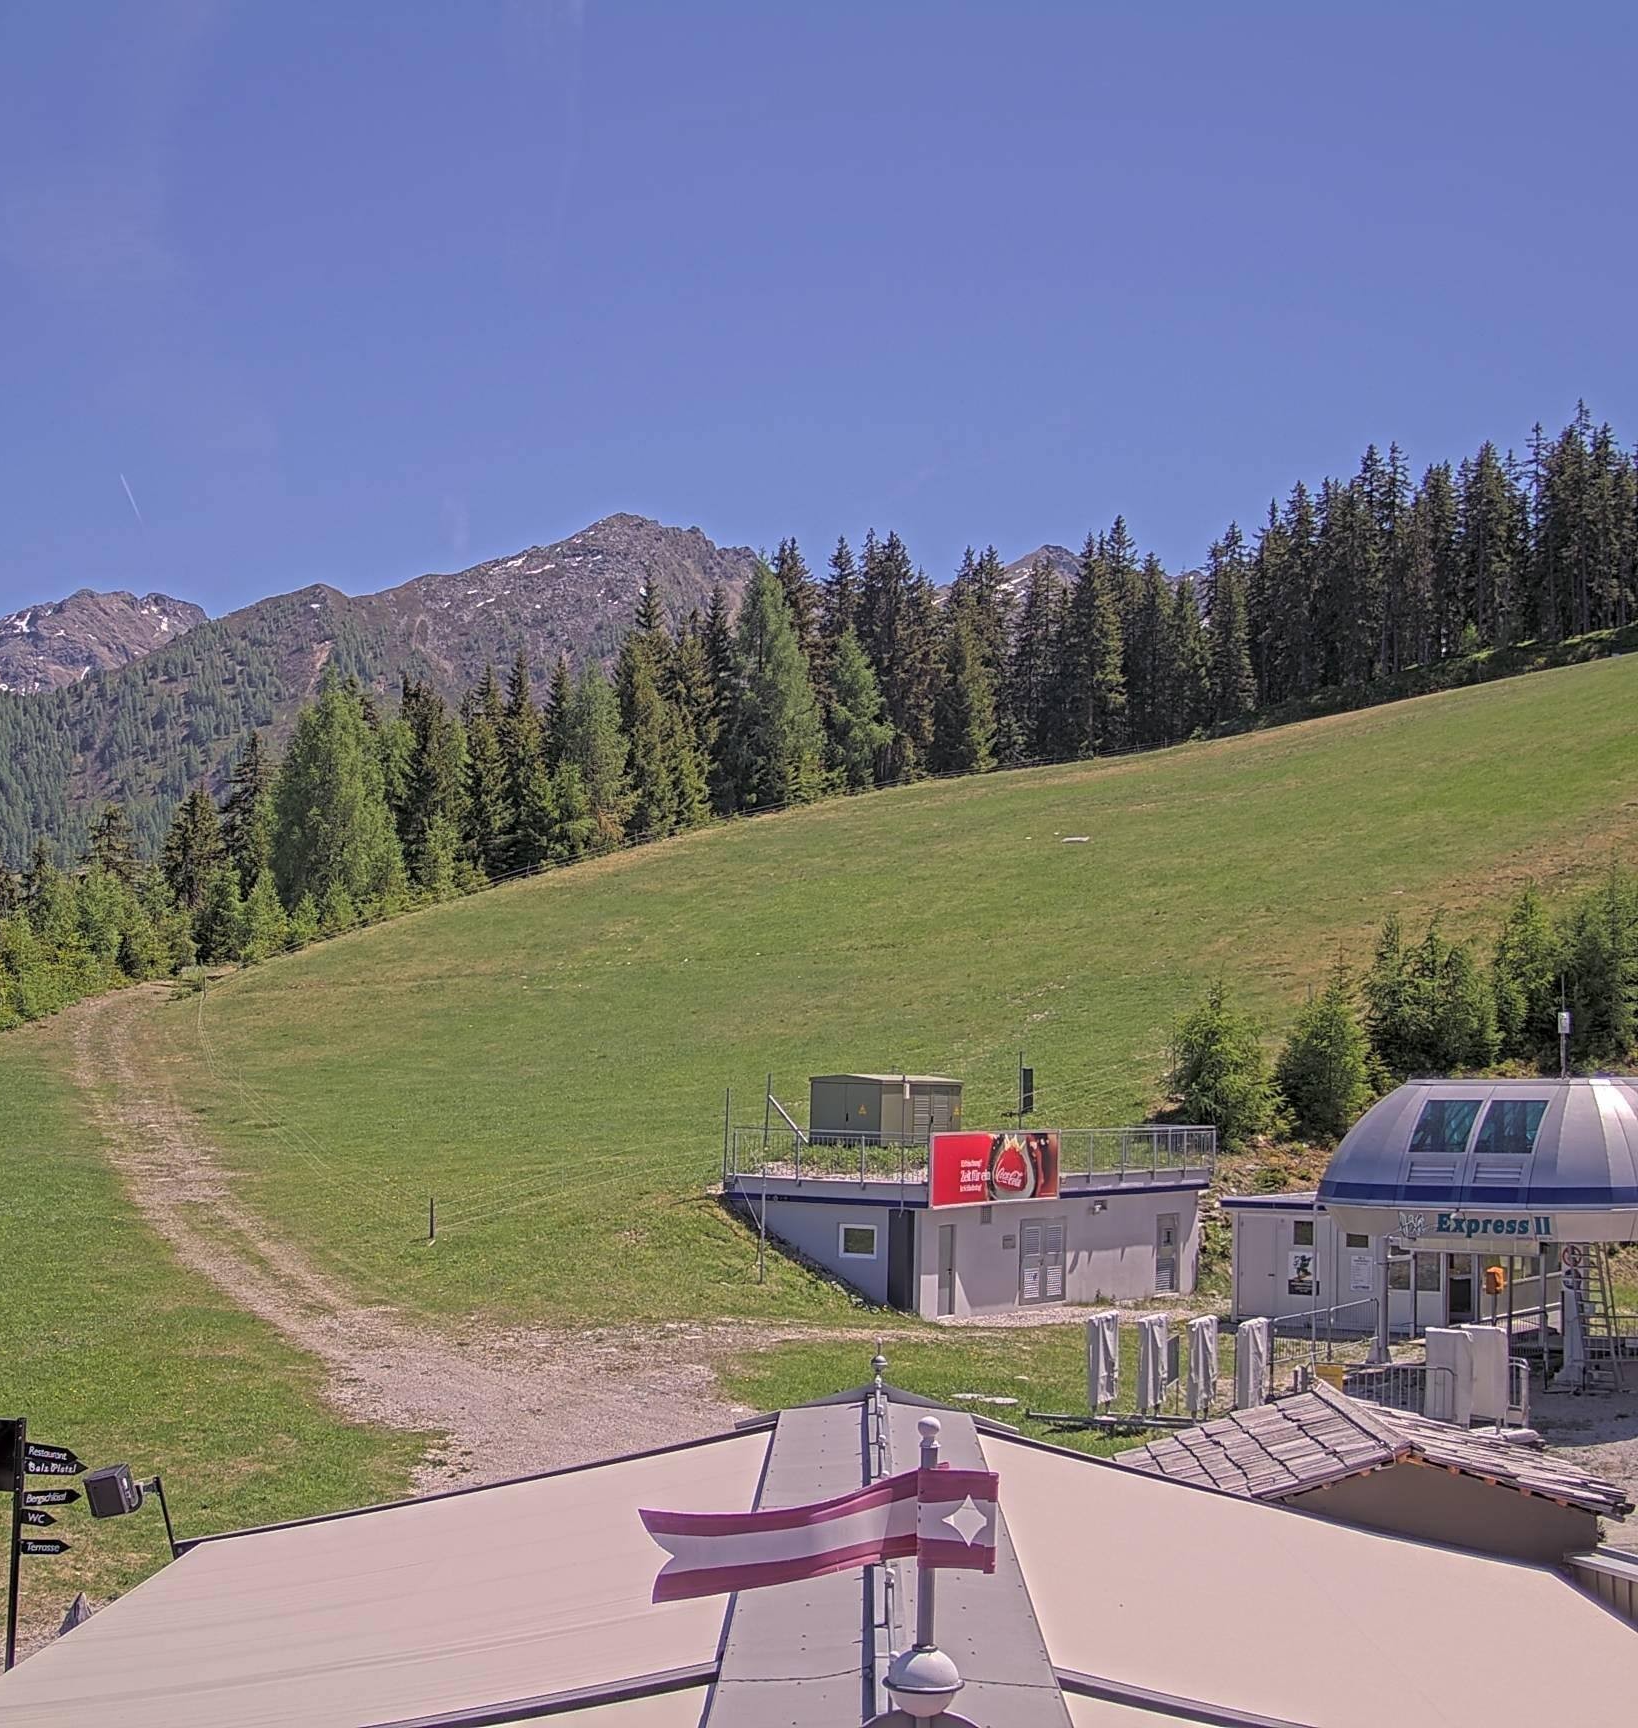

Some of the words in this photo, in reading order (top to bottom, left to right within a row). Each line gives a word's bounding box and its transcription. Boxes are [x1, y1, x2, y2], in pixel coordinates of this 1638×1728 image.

[1437, 1213, 1529, 1237] Express
[28, 1446, 68, 1460] Restaurant
[28, 1512, 45, 1524] WC
[26, 1542, 60, 1553] Terrasse
